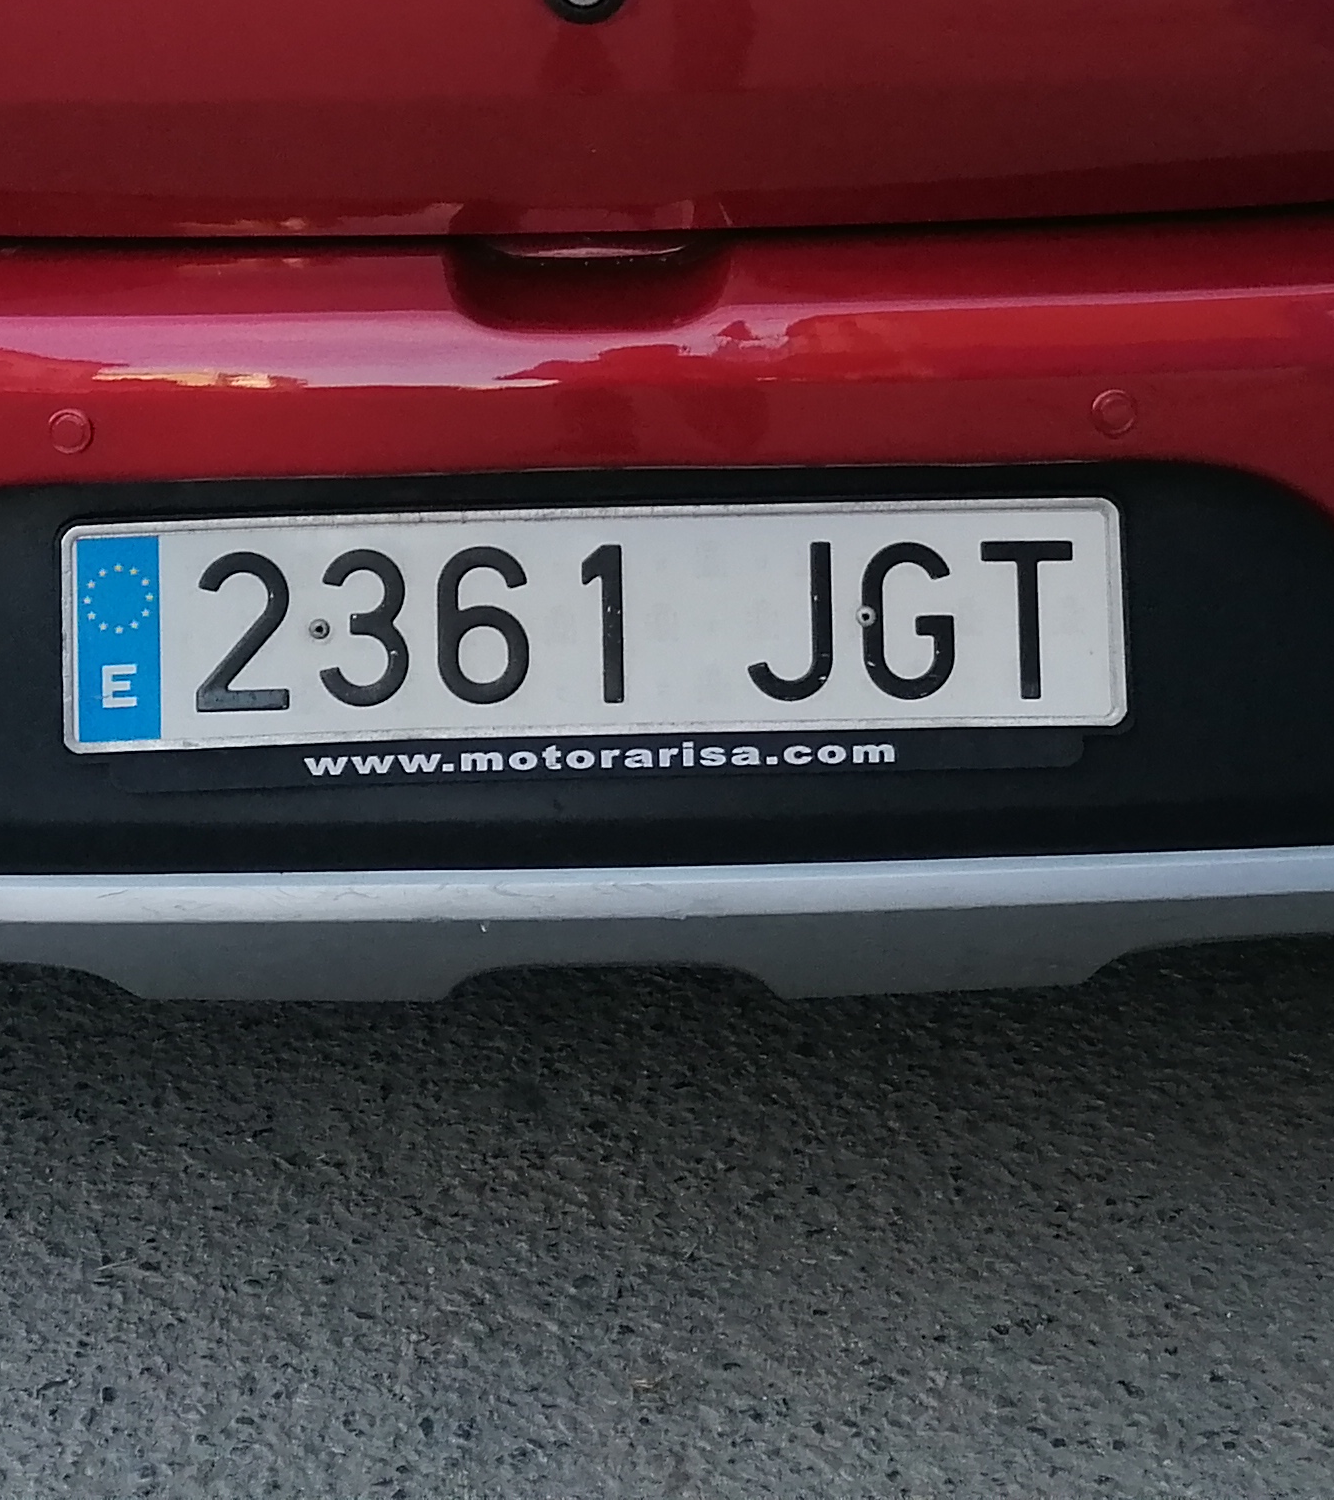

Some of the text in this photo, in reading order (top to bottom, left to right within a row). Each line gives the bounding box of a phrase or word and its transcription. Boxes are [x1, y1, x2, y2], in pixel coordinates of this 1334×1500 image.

[196, 540, 1074, 713] 2361 JGT
[101, 663, 138, 708] E
[303, 740, 897, 776] www.motorarisa.com
